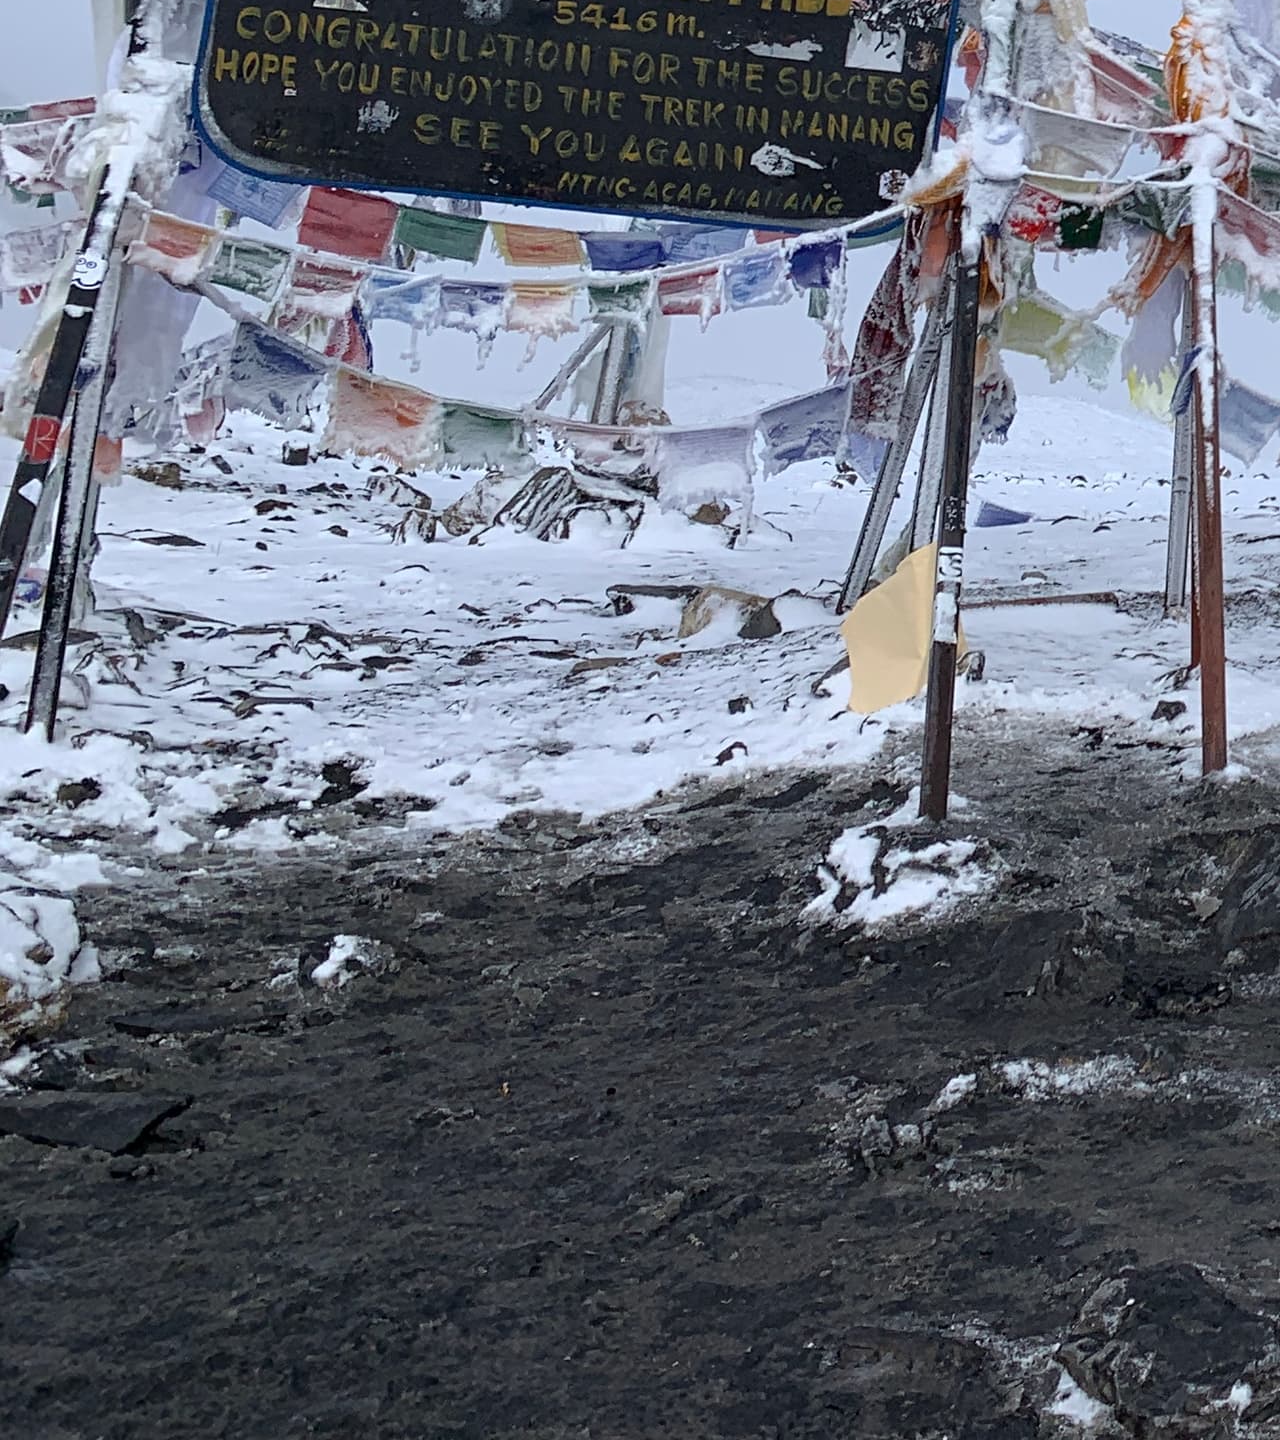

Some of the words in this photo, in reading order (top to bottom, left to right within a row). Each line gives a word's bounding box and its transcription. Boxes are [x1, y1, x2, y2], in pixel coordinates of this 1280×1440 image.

[214, 47, 298, 89] HOPE
[314, 58, 381, 95] YOU
[390, 66, 543, 113] ENJOYED
[558, 85, 626, 121] THE
[640, 93, 725, 130] TREK
[735, 104, 770, 135] IN
[780, 109, 916, 152] MANANG
[236, 6, 591, 77] CONGRATULATION
[608, 47, 681, 86] FOR
[692, 56, 765, 94] THE
[775, 66, 930, 112] SUCCESS
[413, 113, 502, 151] SEE
[520, 123, 607, 162] YOU
[619, 133, 744, 172] AGAIN
